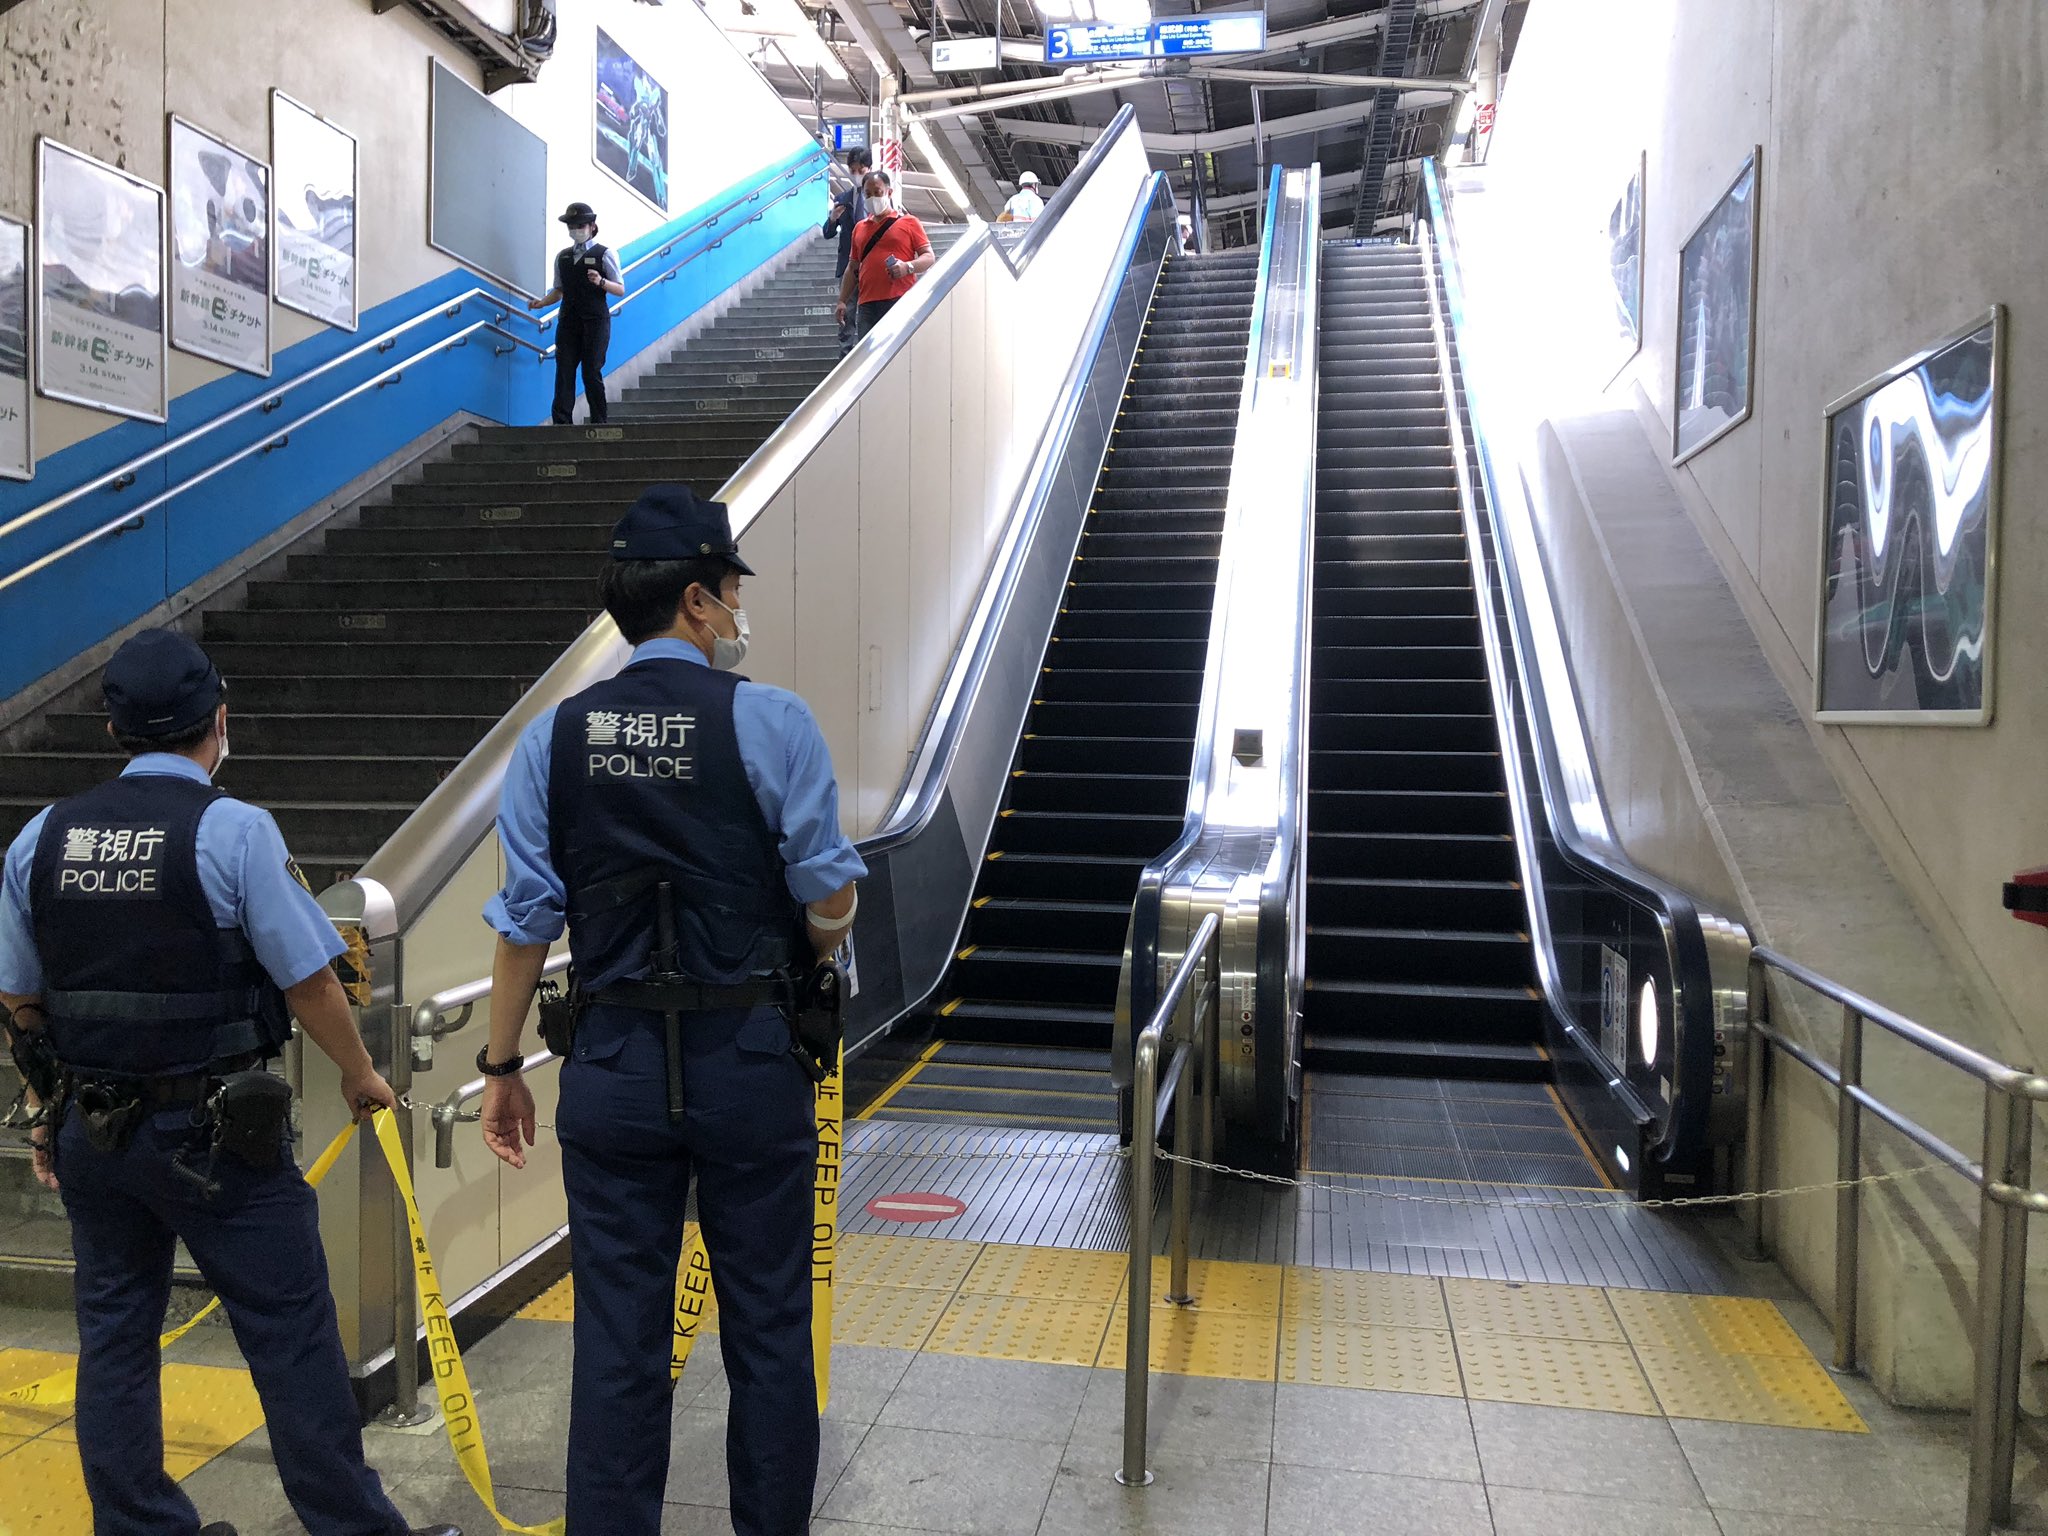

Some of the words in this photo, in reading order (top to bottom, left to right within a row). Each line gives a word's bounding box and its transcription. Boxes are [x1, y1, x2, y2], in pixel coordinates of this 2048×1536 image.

[1051, 30, 1069, 59] 3
[1393, 236, 1401, 246] 4
[79, 362, 99, 377] 3.14
[101, 369, 128, 384] START
[585, 710, 696, 749] 警視庁
[588, 753, 694, 780] POLICE
[63, 826, 166, 862] 警視庁
[60, 868, 157, 893] POLICE
[814, 1117, 839, 1206] KEEP
[811, 1222, 834, 1289] OUT
[673, 1250, 711, 1338] KEEP
